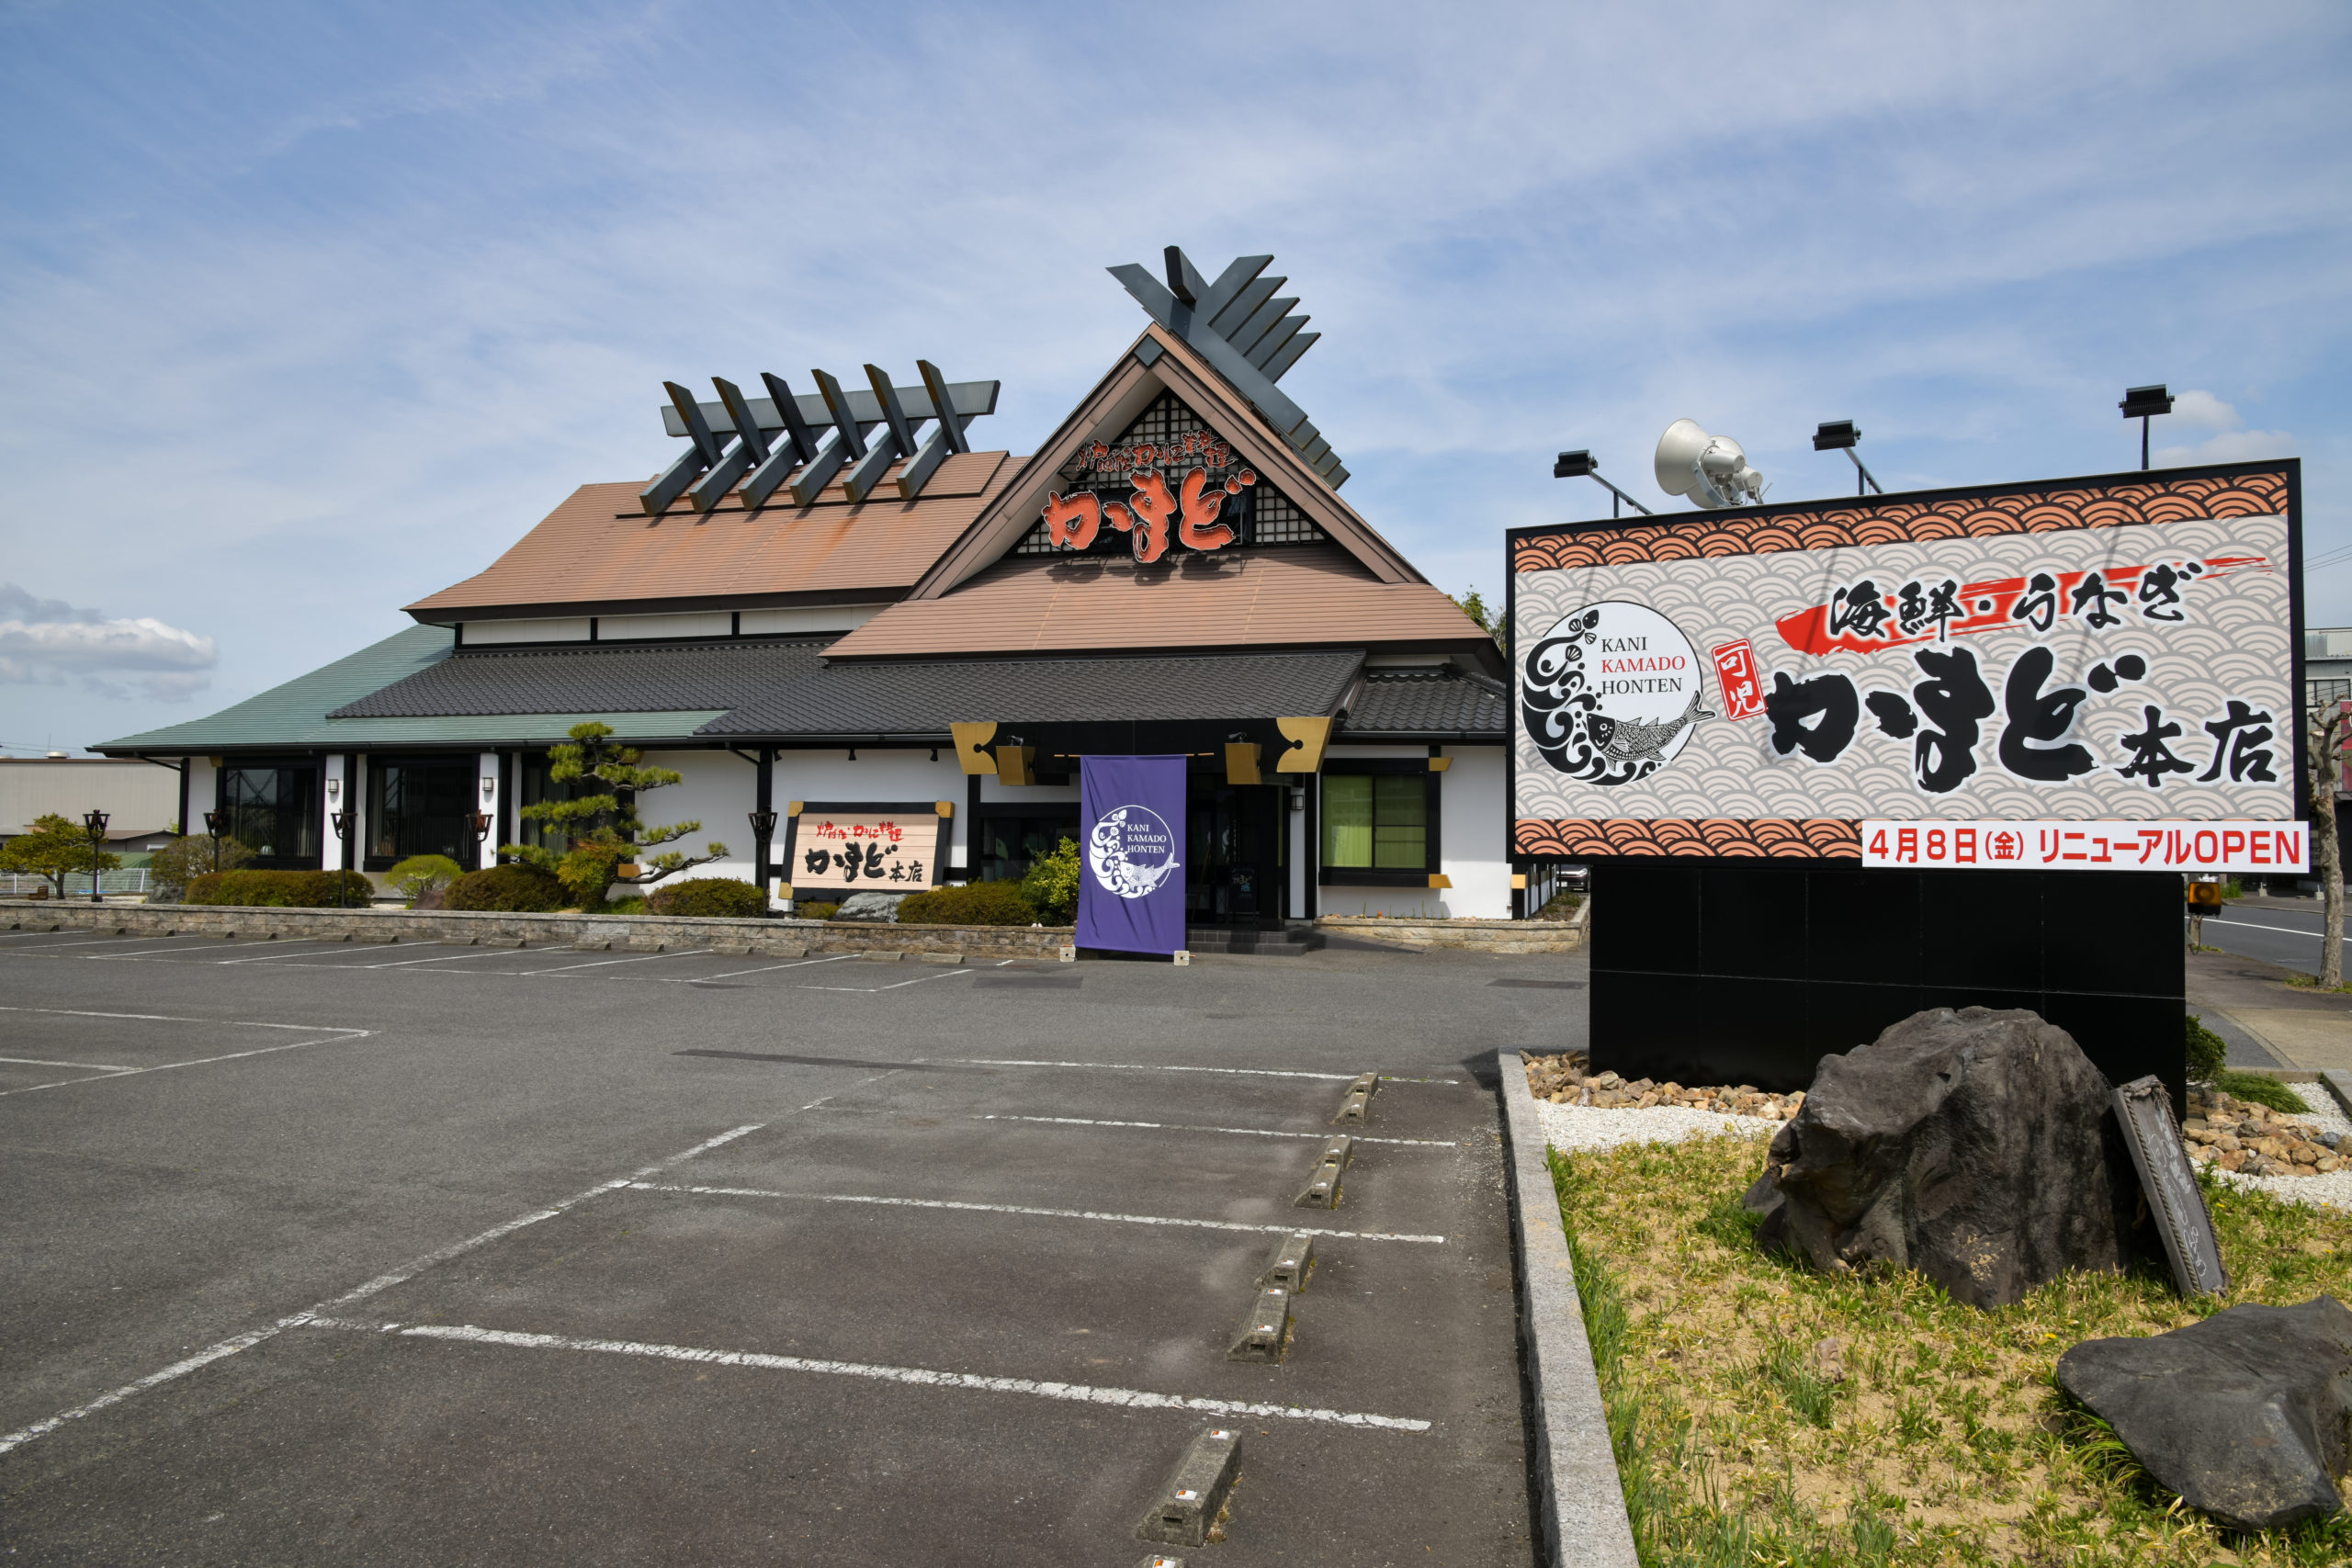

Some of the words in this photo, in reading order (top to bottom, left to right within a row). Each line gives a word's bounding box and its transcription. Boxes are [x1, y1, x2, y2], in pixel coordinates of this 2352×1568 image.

[1042, 466, 1256, 563] かまど
[1830, 562, 2202, 642] 海鮮・うなぎ
[1601, 637, 1647, 653] KANI
[1601, 656, 1686, 673] KAMADO
[1601, 677, 1682, 694] HONTEN
[1715, 645, 1763, 718] 可児
[1126, 824, 1149, 832] KANI
[1126, 834, 1167, 843] KAMADO
[1126, 845, 1165, 854] HONTEN
